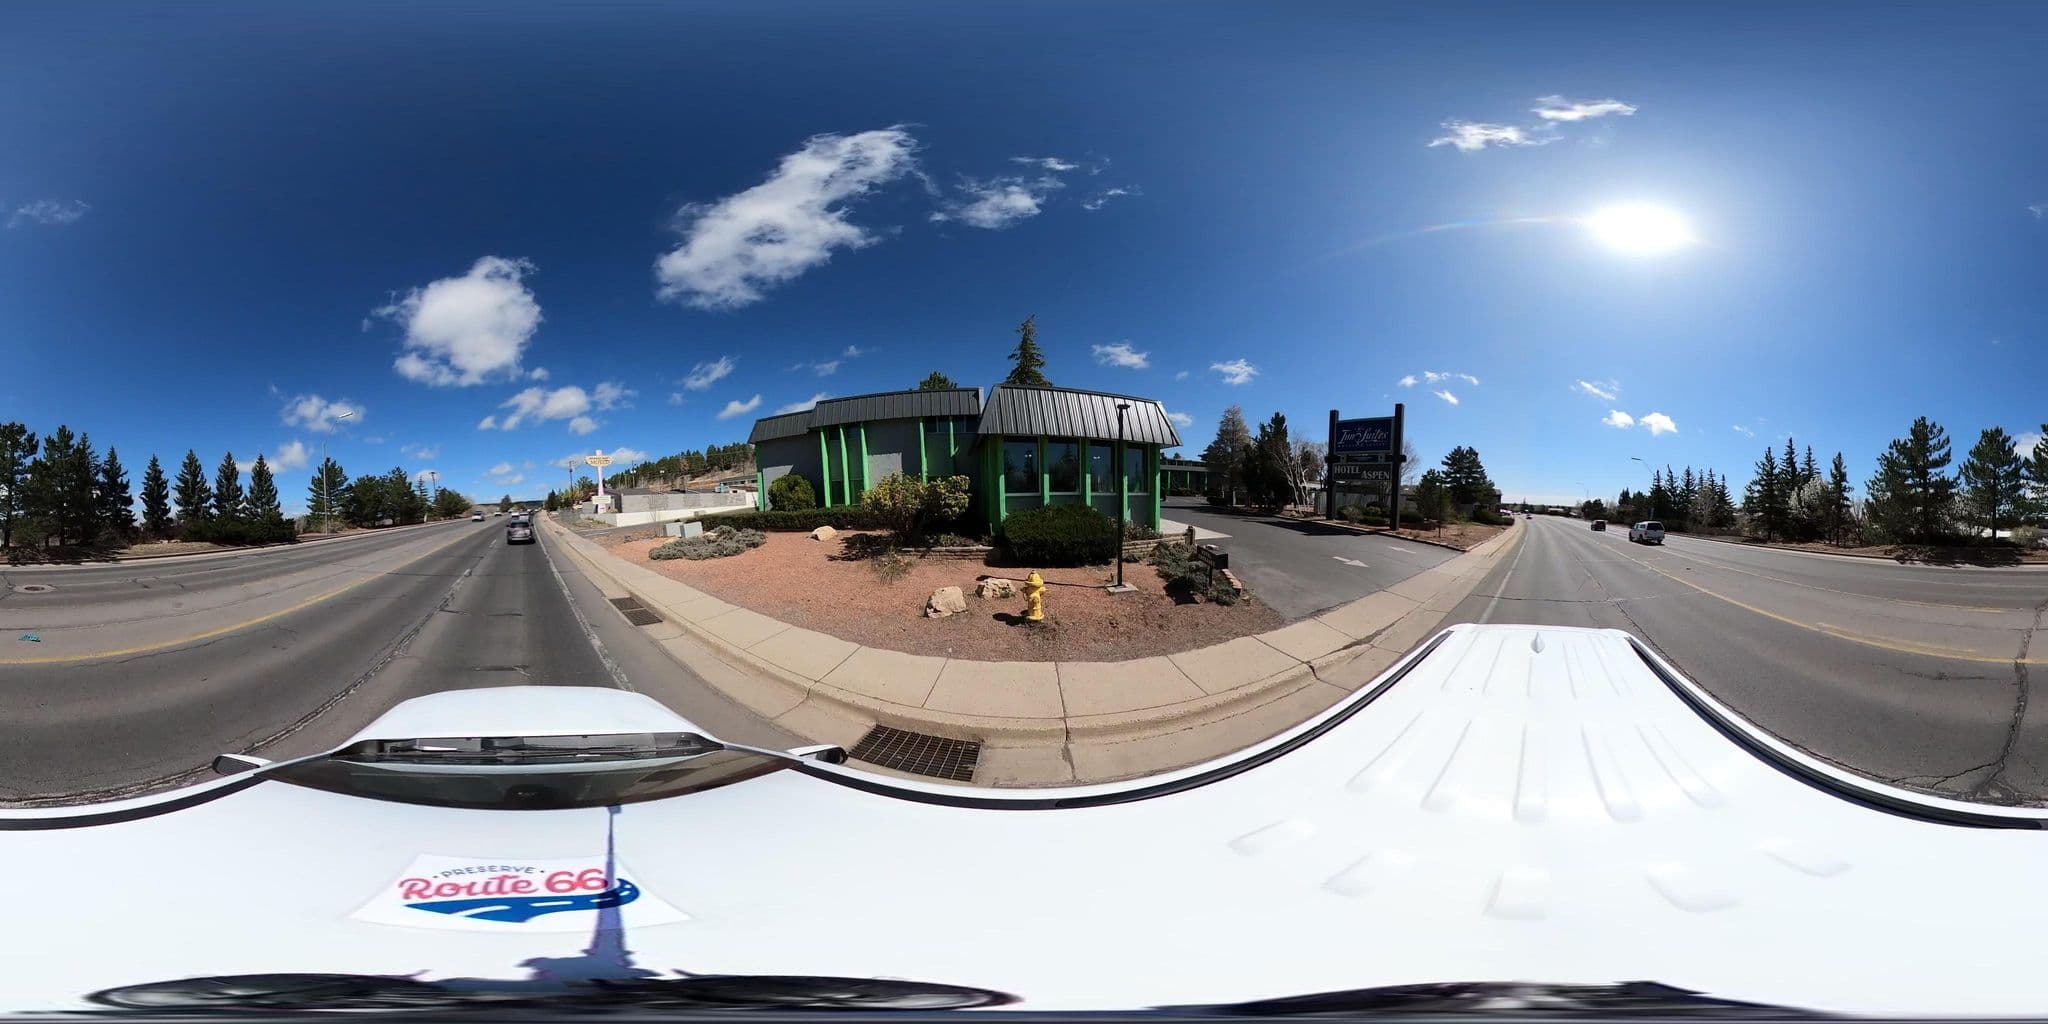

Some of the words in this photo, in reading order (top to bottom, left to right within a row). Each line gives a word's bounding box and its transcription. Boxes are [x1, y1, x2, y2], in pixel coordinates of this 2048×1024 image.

[1334, 465, 1361, 474] HOTEL
[1361, 470, 1390, 480] ASPEN
[441, 865, 536, 879] PRESERVE
[397, 873, 540, 900] Route
[544, 868, 609, 894] 66
